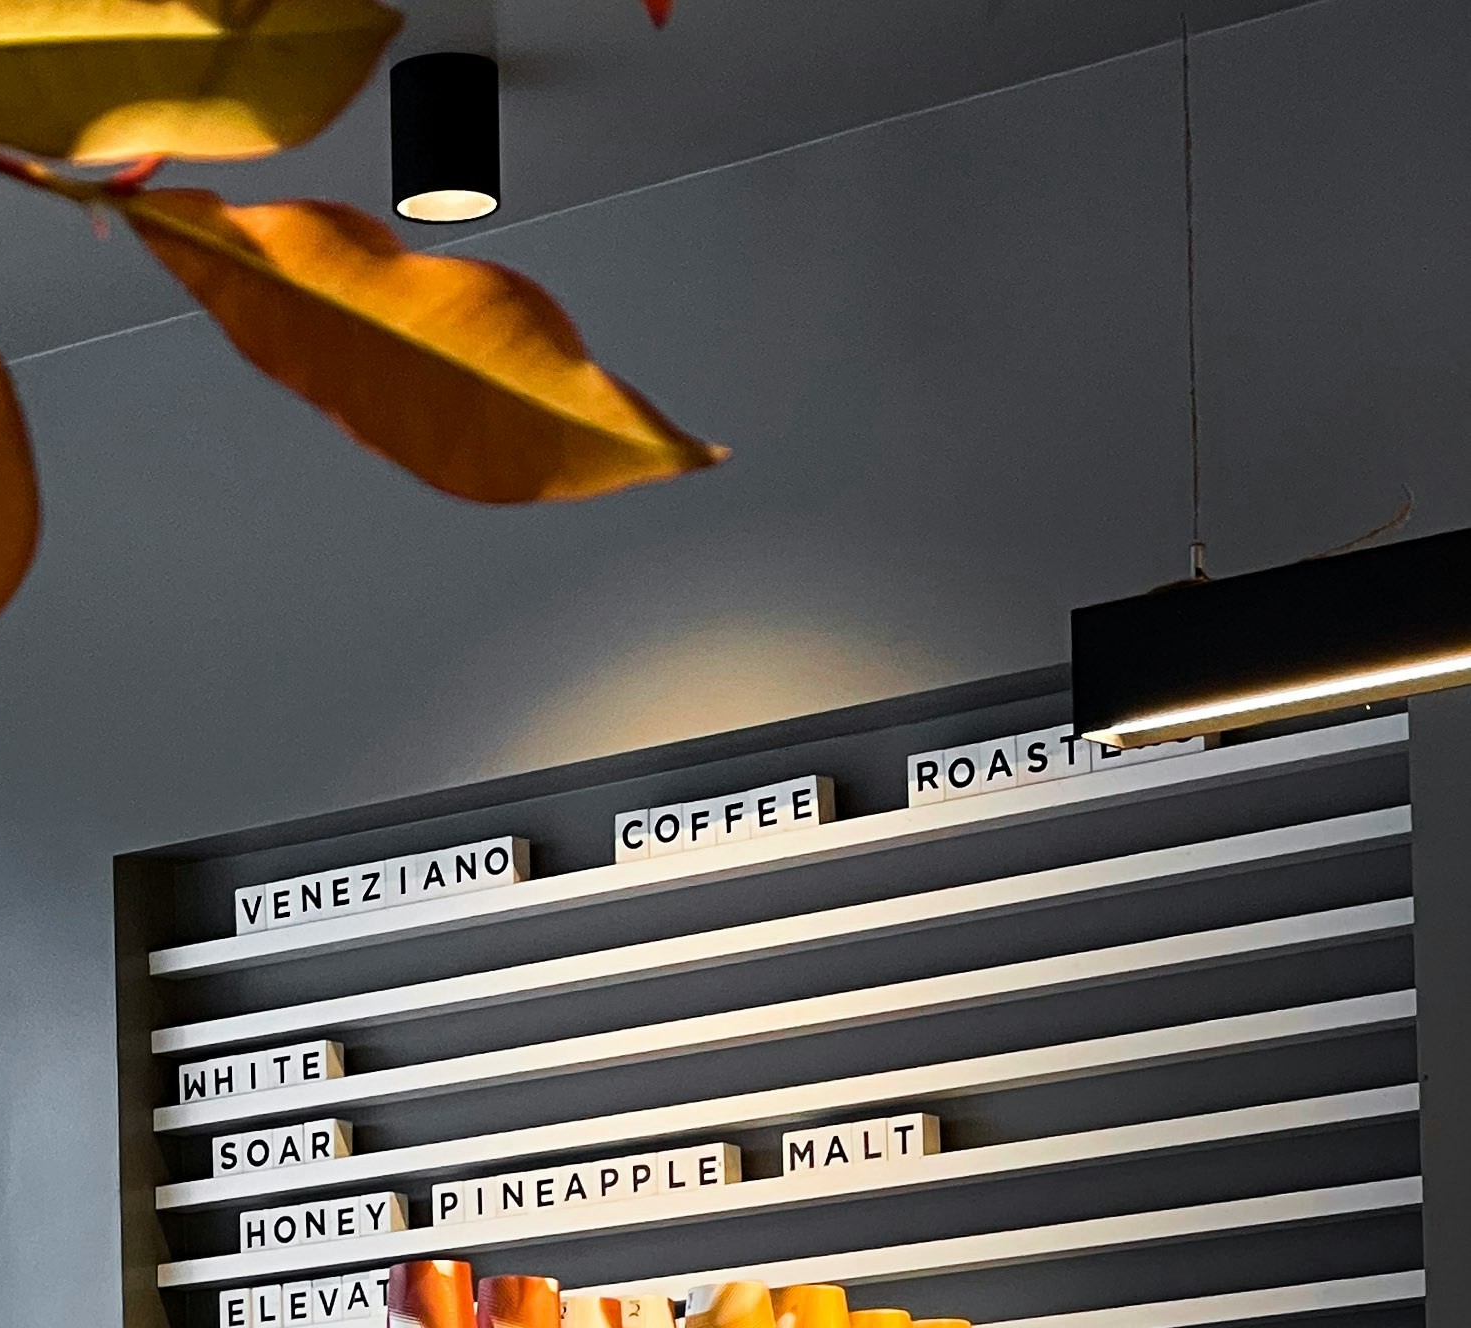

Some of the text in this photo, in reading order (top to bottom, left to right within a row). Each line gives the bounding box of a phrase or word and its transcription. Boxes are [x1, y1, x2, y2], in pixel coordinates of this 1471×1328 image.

[242, 734, 1192, 925] VENEZIANO COFFEE ROAST
[183, 1051, 321, 1099] WHITE
[219, 1130, 331, 1170] SOAR
[246, 1124, 915, 1248] HONEY PINEAPPLE MALT
